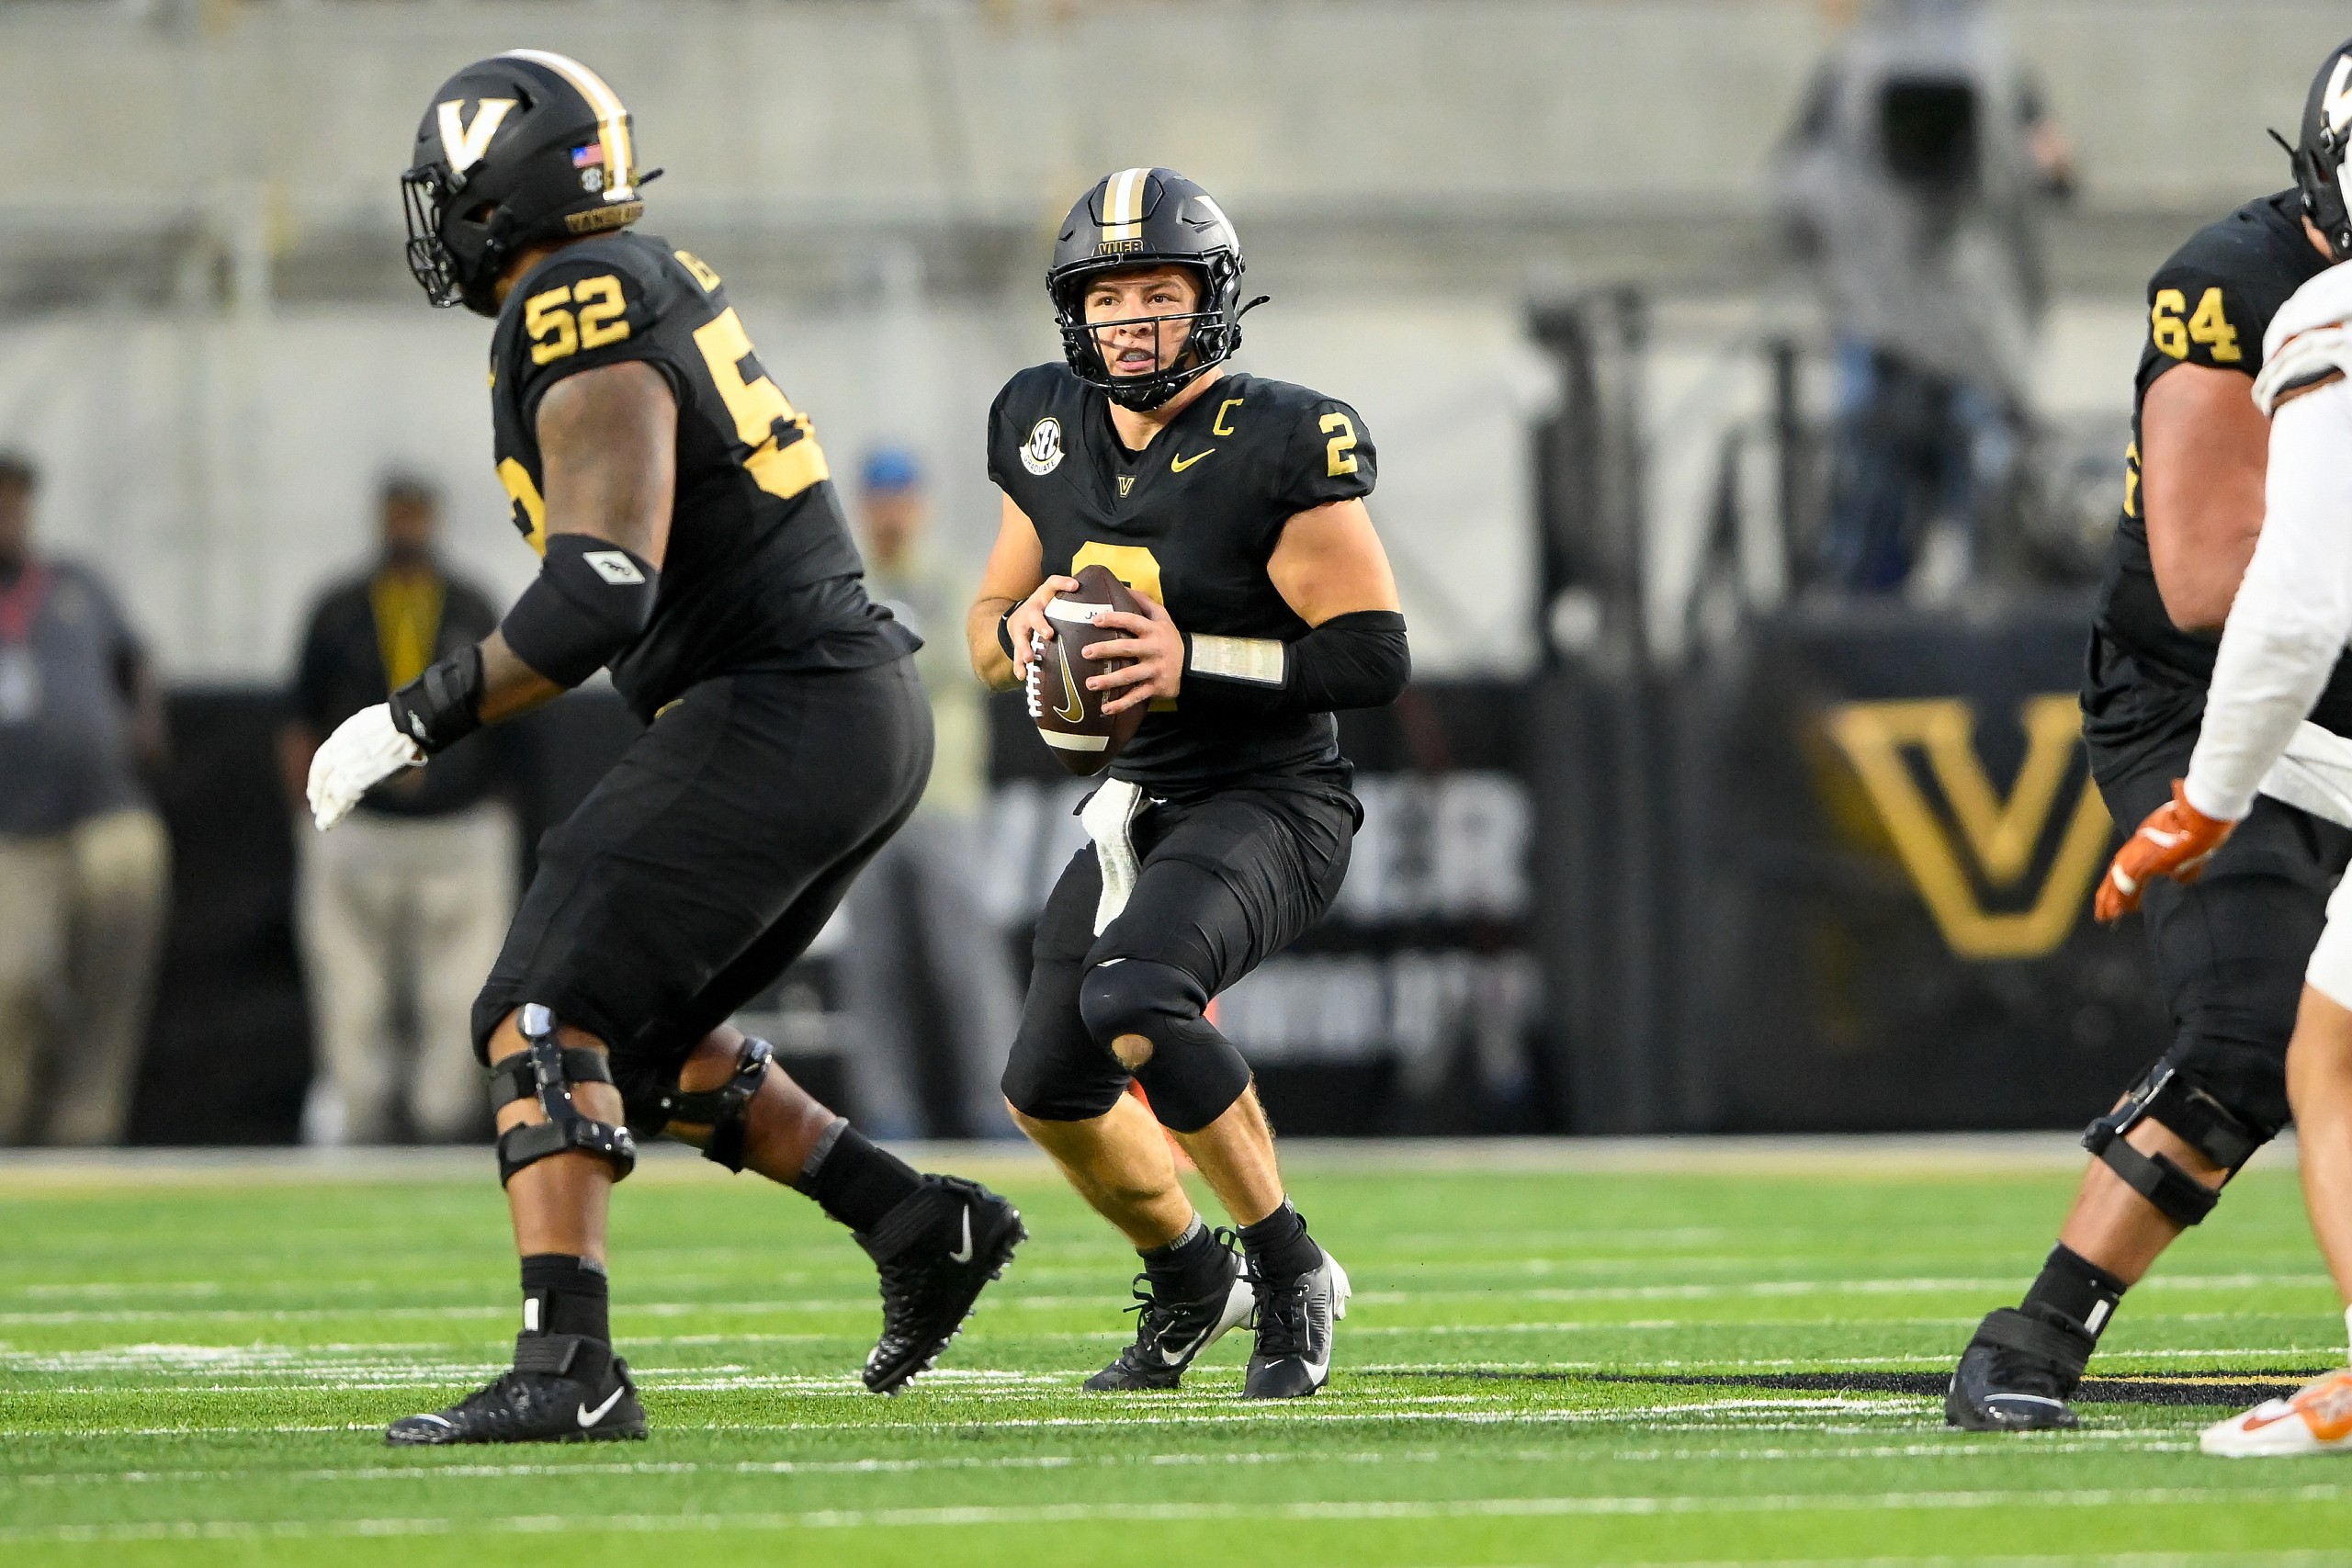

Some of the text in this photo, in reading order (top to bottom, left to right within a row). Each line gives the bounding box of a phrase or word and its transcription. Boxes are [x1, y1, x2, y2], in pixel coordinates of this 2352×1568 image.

[437, 98, 517, 174] V
[525, 275, 631, 366] 52
[2152, 288, 2243, 362] 64
[1031, 420, 1059, 460] SEC
[1213, 399, 1243, 436] C
[1023, 454, 1057, 473] GRADUATE
[1318, 412, 1358, 477] 2
[1117, 476, 1135, 497] V
